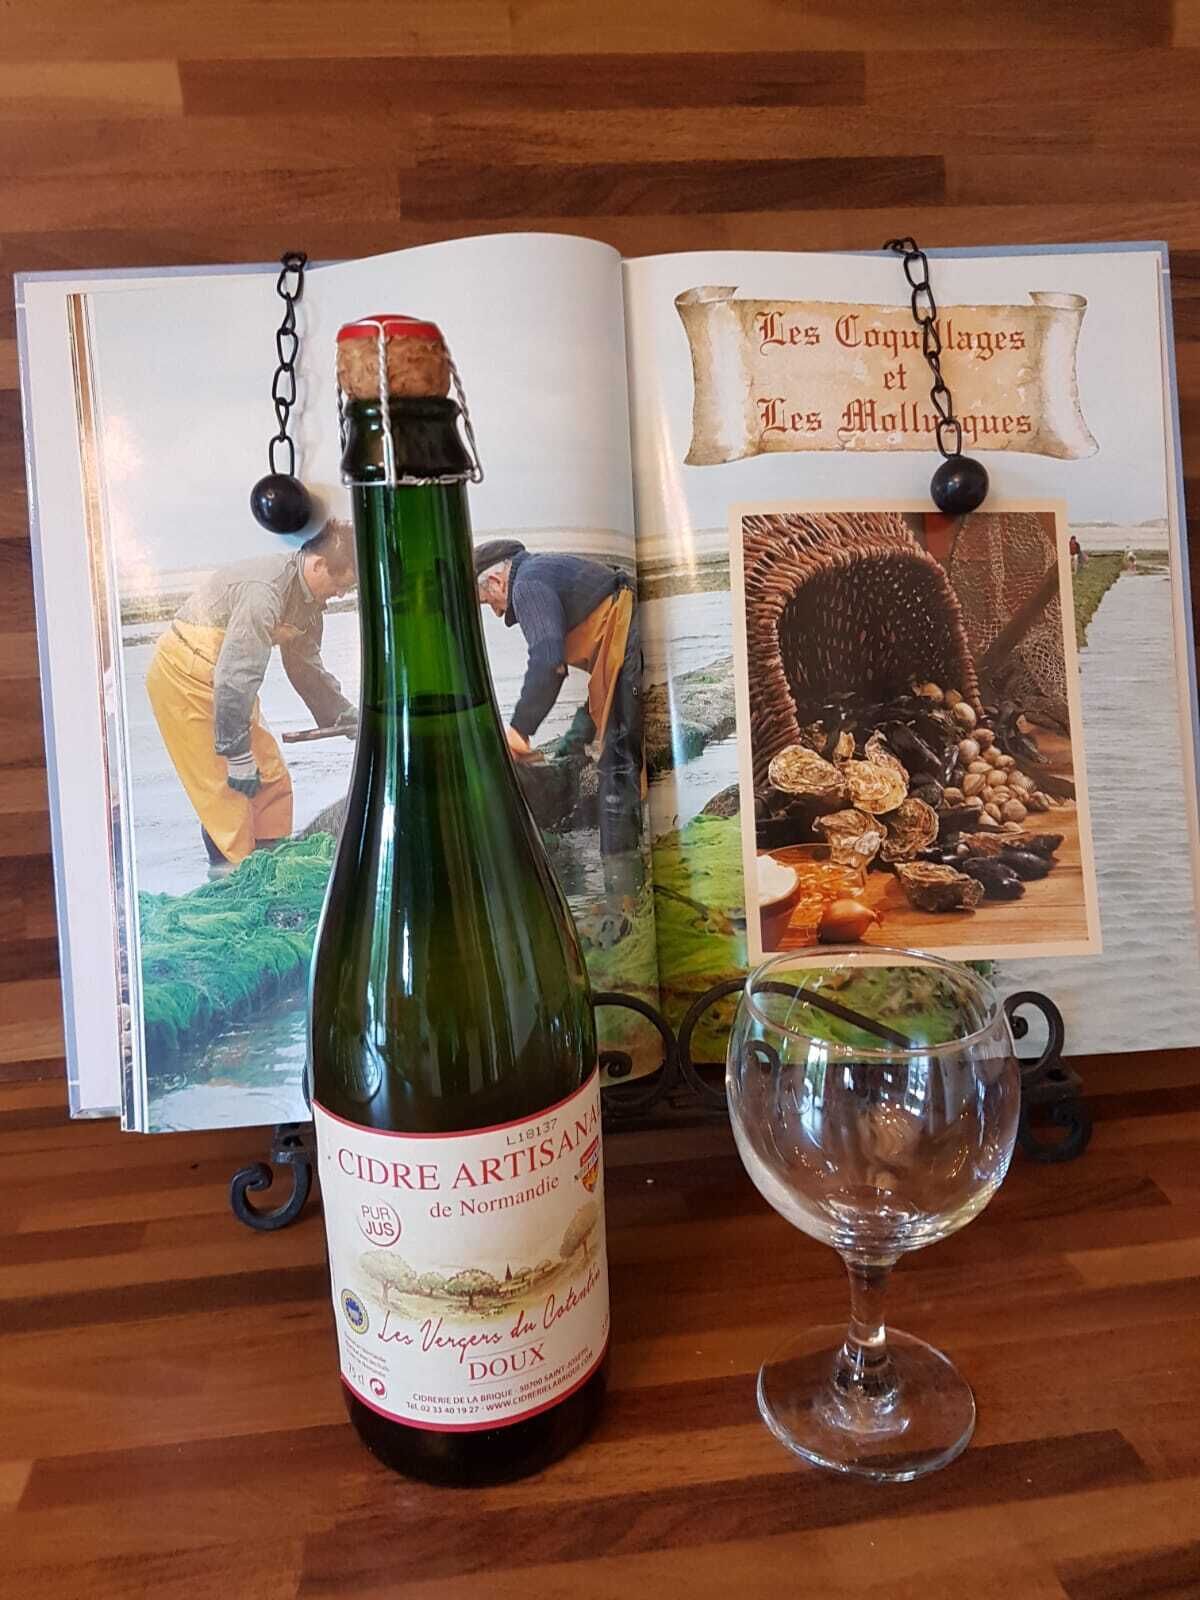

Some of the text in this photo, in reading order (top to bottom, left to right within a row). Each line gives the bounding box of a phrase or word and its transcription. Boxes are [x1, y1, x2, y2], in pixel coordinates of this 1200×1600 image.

[754, 311, 1026, 361] Les Coqullages
[883, 364, 908, 391] et
[756, 398, 822, 442] Les
[506, 1118, 558, 1146] L18137
[338, 1148, 441, 1191] CIDRE
[361, 1204, 391, 1221] PUR
[430, 1174, 560, 1219] de Normandie
[365, 1221, 395, 1238] JUS
[377, 1310, 414, 1345] Les
[420, 1317, 503, 1364] Vergers
[510, 1311, 537, 1339] du
[468, 1342, 545, 1380] DOUX
[412, 1393, 452, 1405] CIDRERIE
[453, 1396, 466, 1405] DE
[467, 1395, 479, 1405] LA
[480, 1389, 513, 1402] BRIQUE
